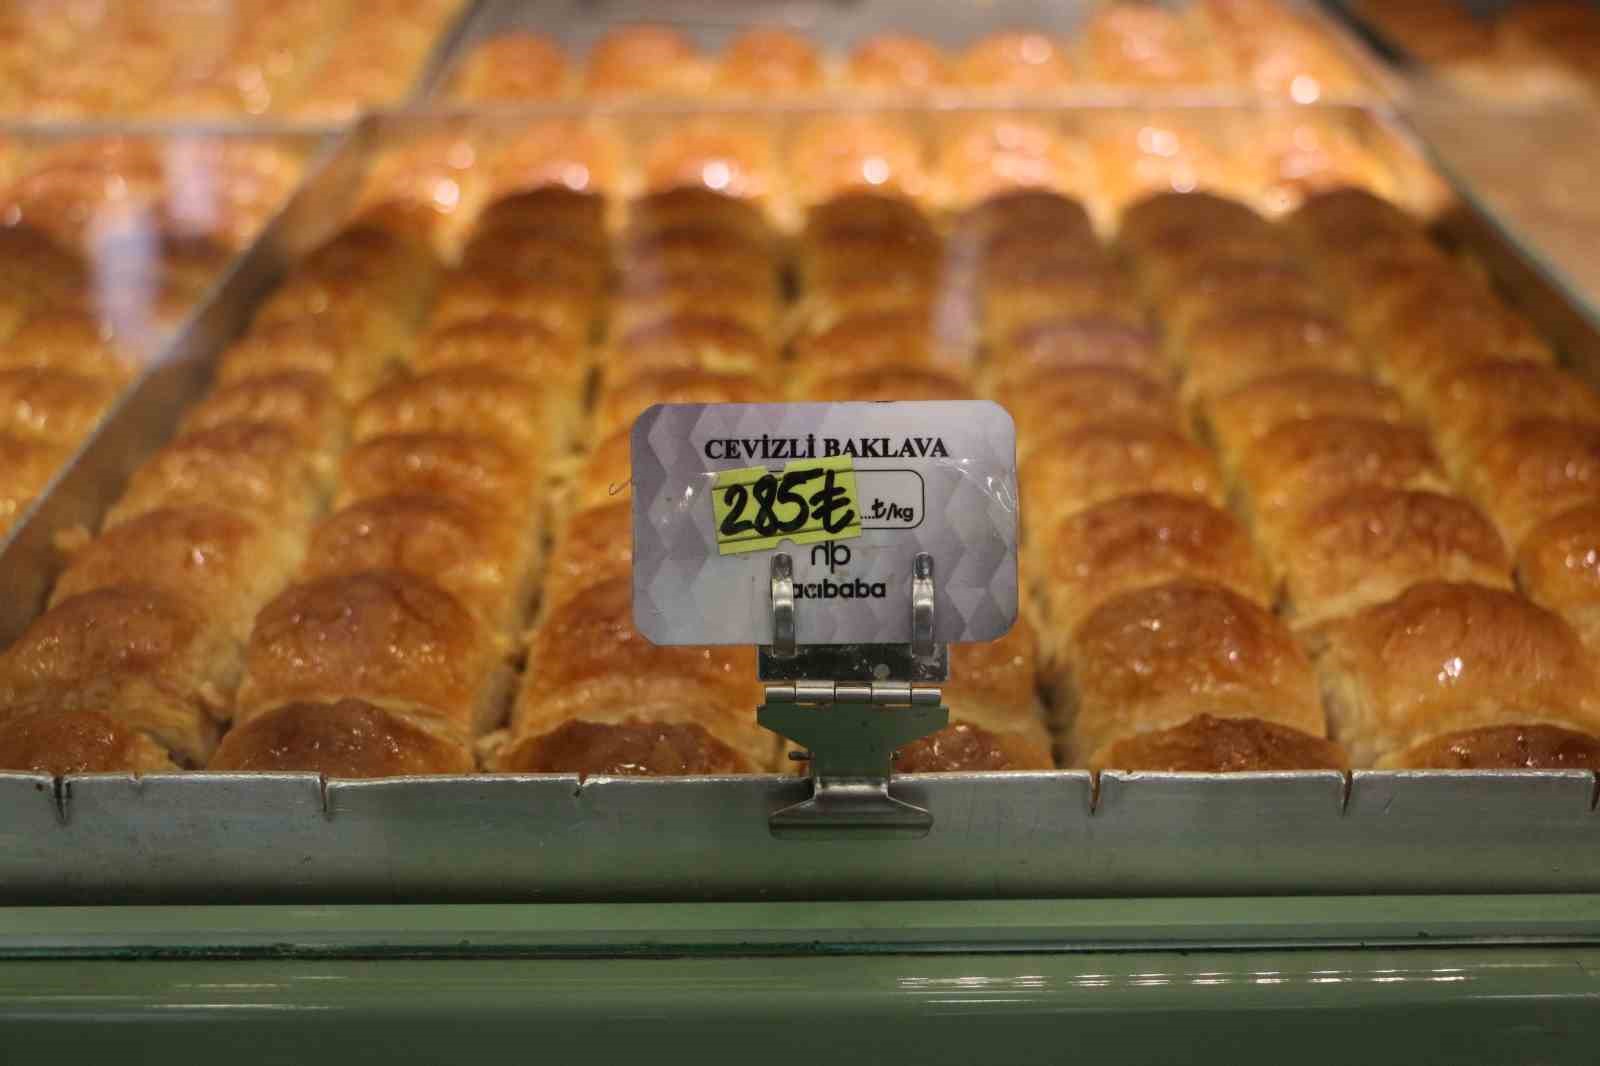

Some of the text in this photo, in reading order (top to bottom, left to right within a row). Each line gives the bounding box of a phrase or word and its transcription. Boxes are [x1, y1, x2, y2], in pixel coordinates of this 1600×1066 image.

[704, 434, 949, 459] CEVİZLİ BAKLAVA
[772, 578, 886, 599] acıbaba
